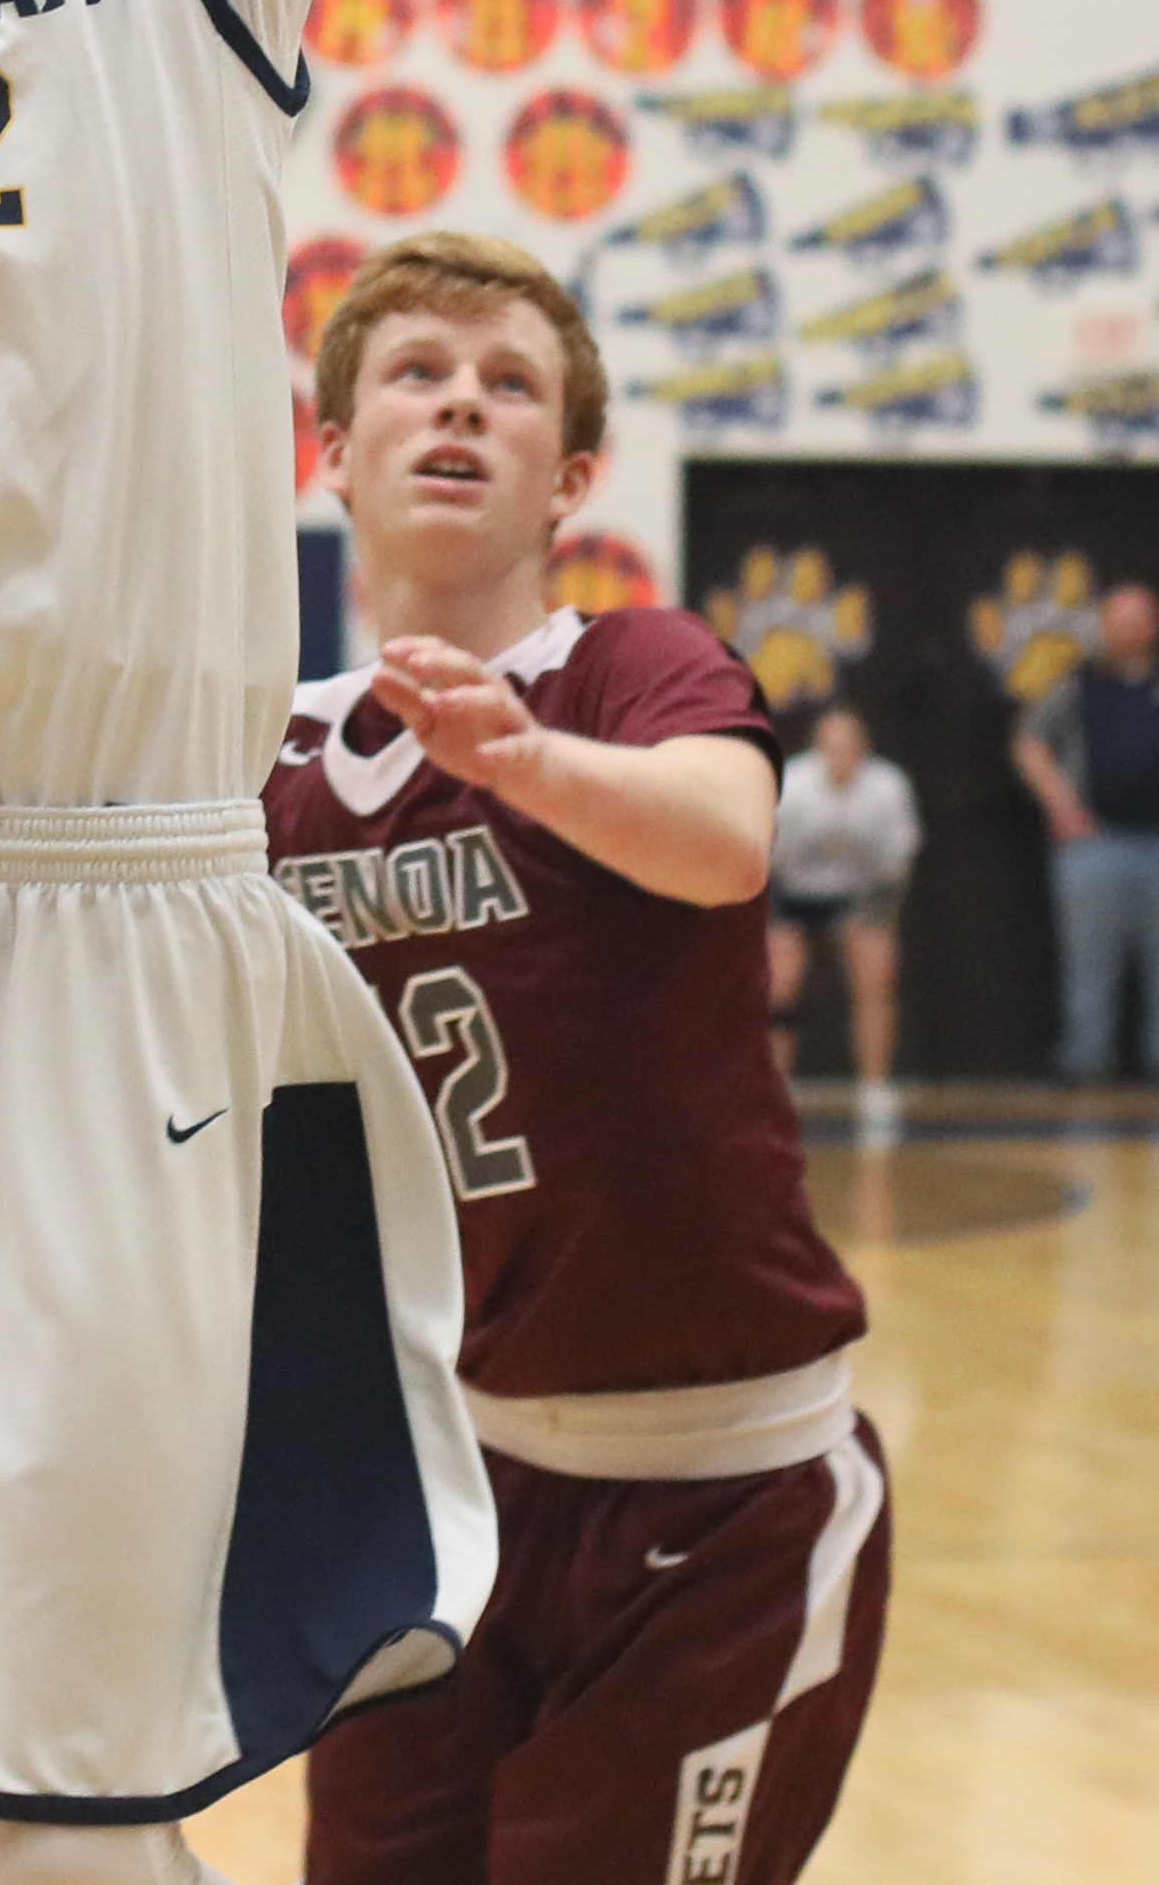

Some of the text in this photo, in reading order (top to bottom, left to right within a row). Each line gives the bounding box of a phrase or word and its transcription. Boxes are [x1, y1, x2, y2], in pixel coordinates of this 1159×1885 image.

[274, 823, 530, 949] ENOA
[368, 965, 538, 1202] 2
[683, 1767, 744, 1885] ETS
